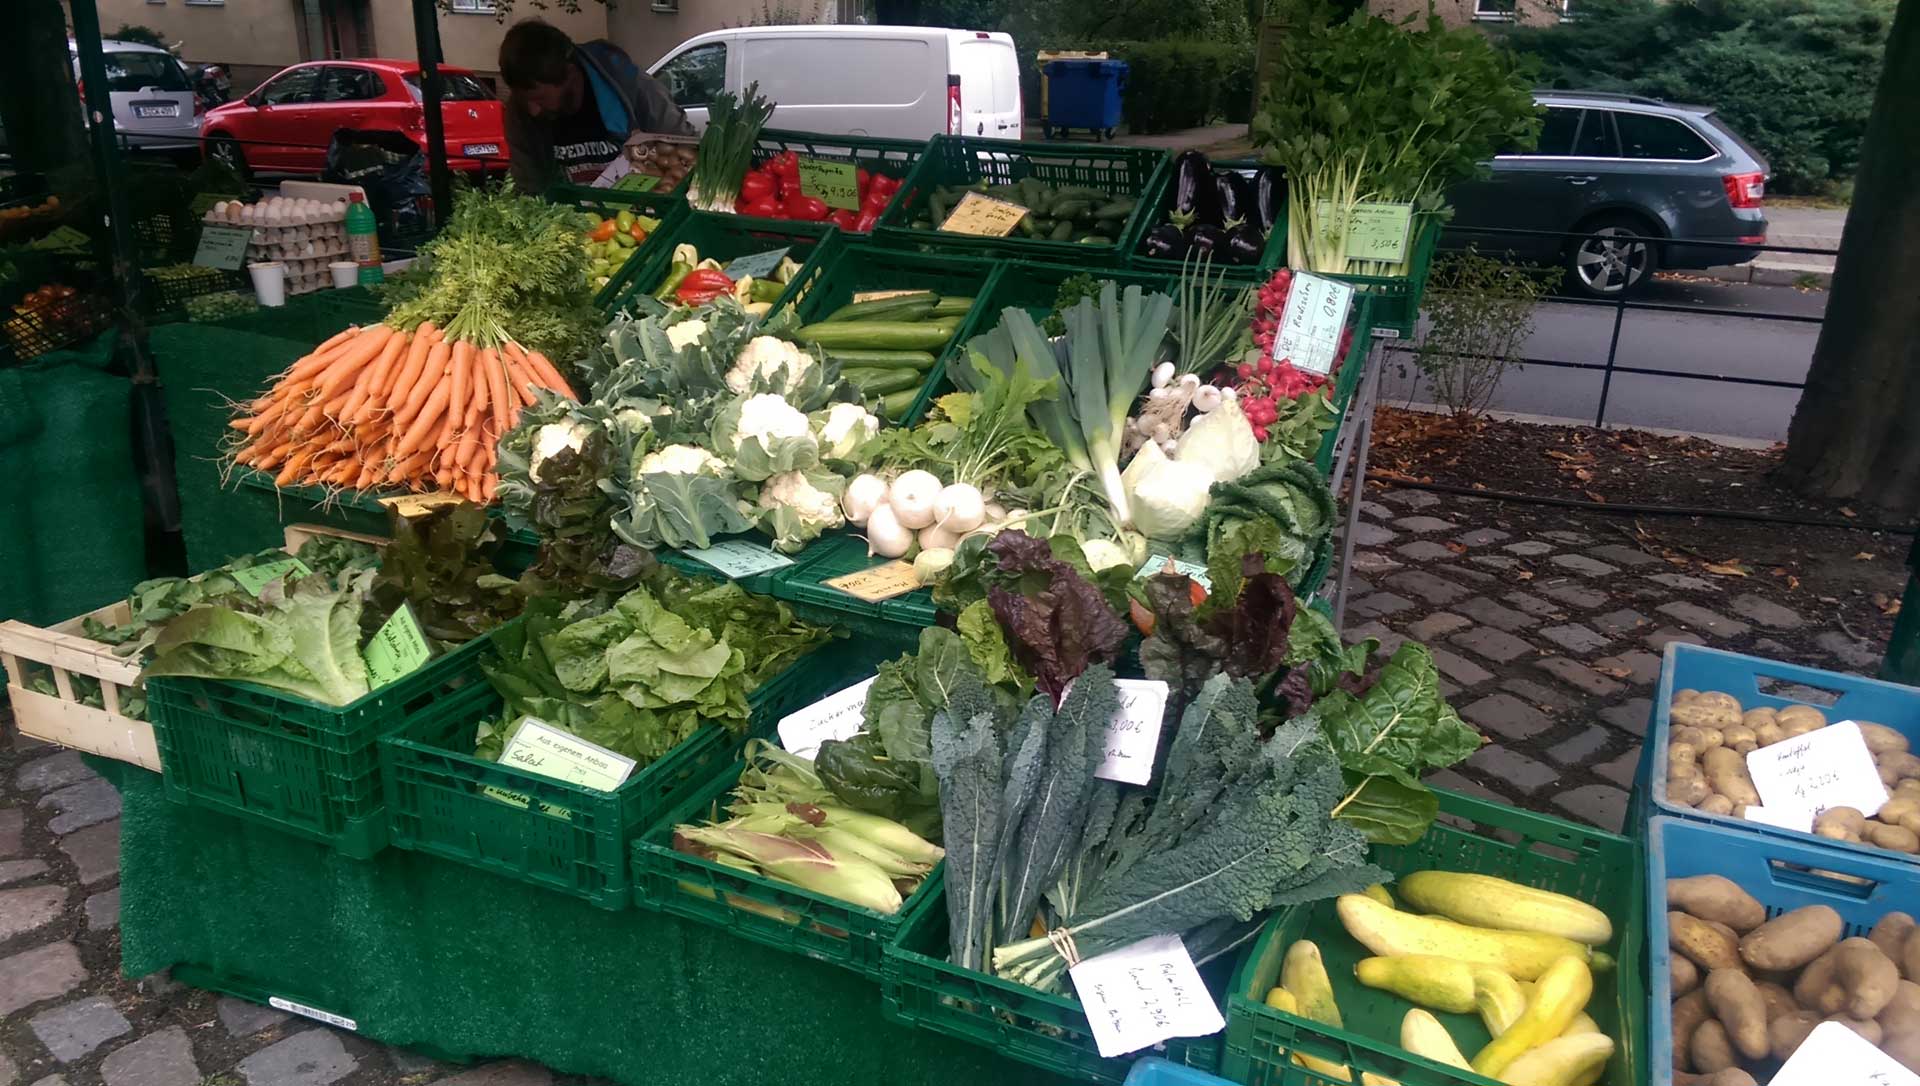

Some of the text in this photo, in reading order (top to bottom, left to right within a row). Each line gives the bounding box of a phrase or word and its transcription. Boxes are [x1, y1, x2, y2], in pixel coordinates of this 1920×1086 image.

[511, 750, 545, 768] Salat
[537, 735, 552, 747] Aus
[553, 742, 583, 760] eigenem
[584, 754, 609, 770] Anbau
